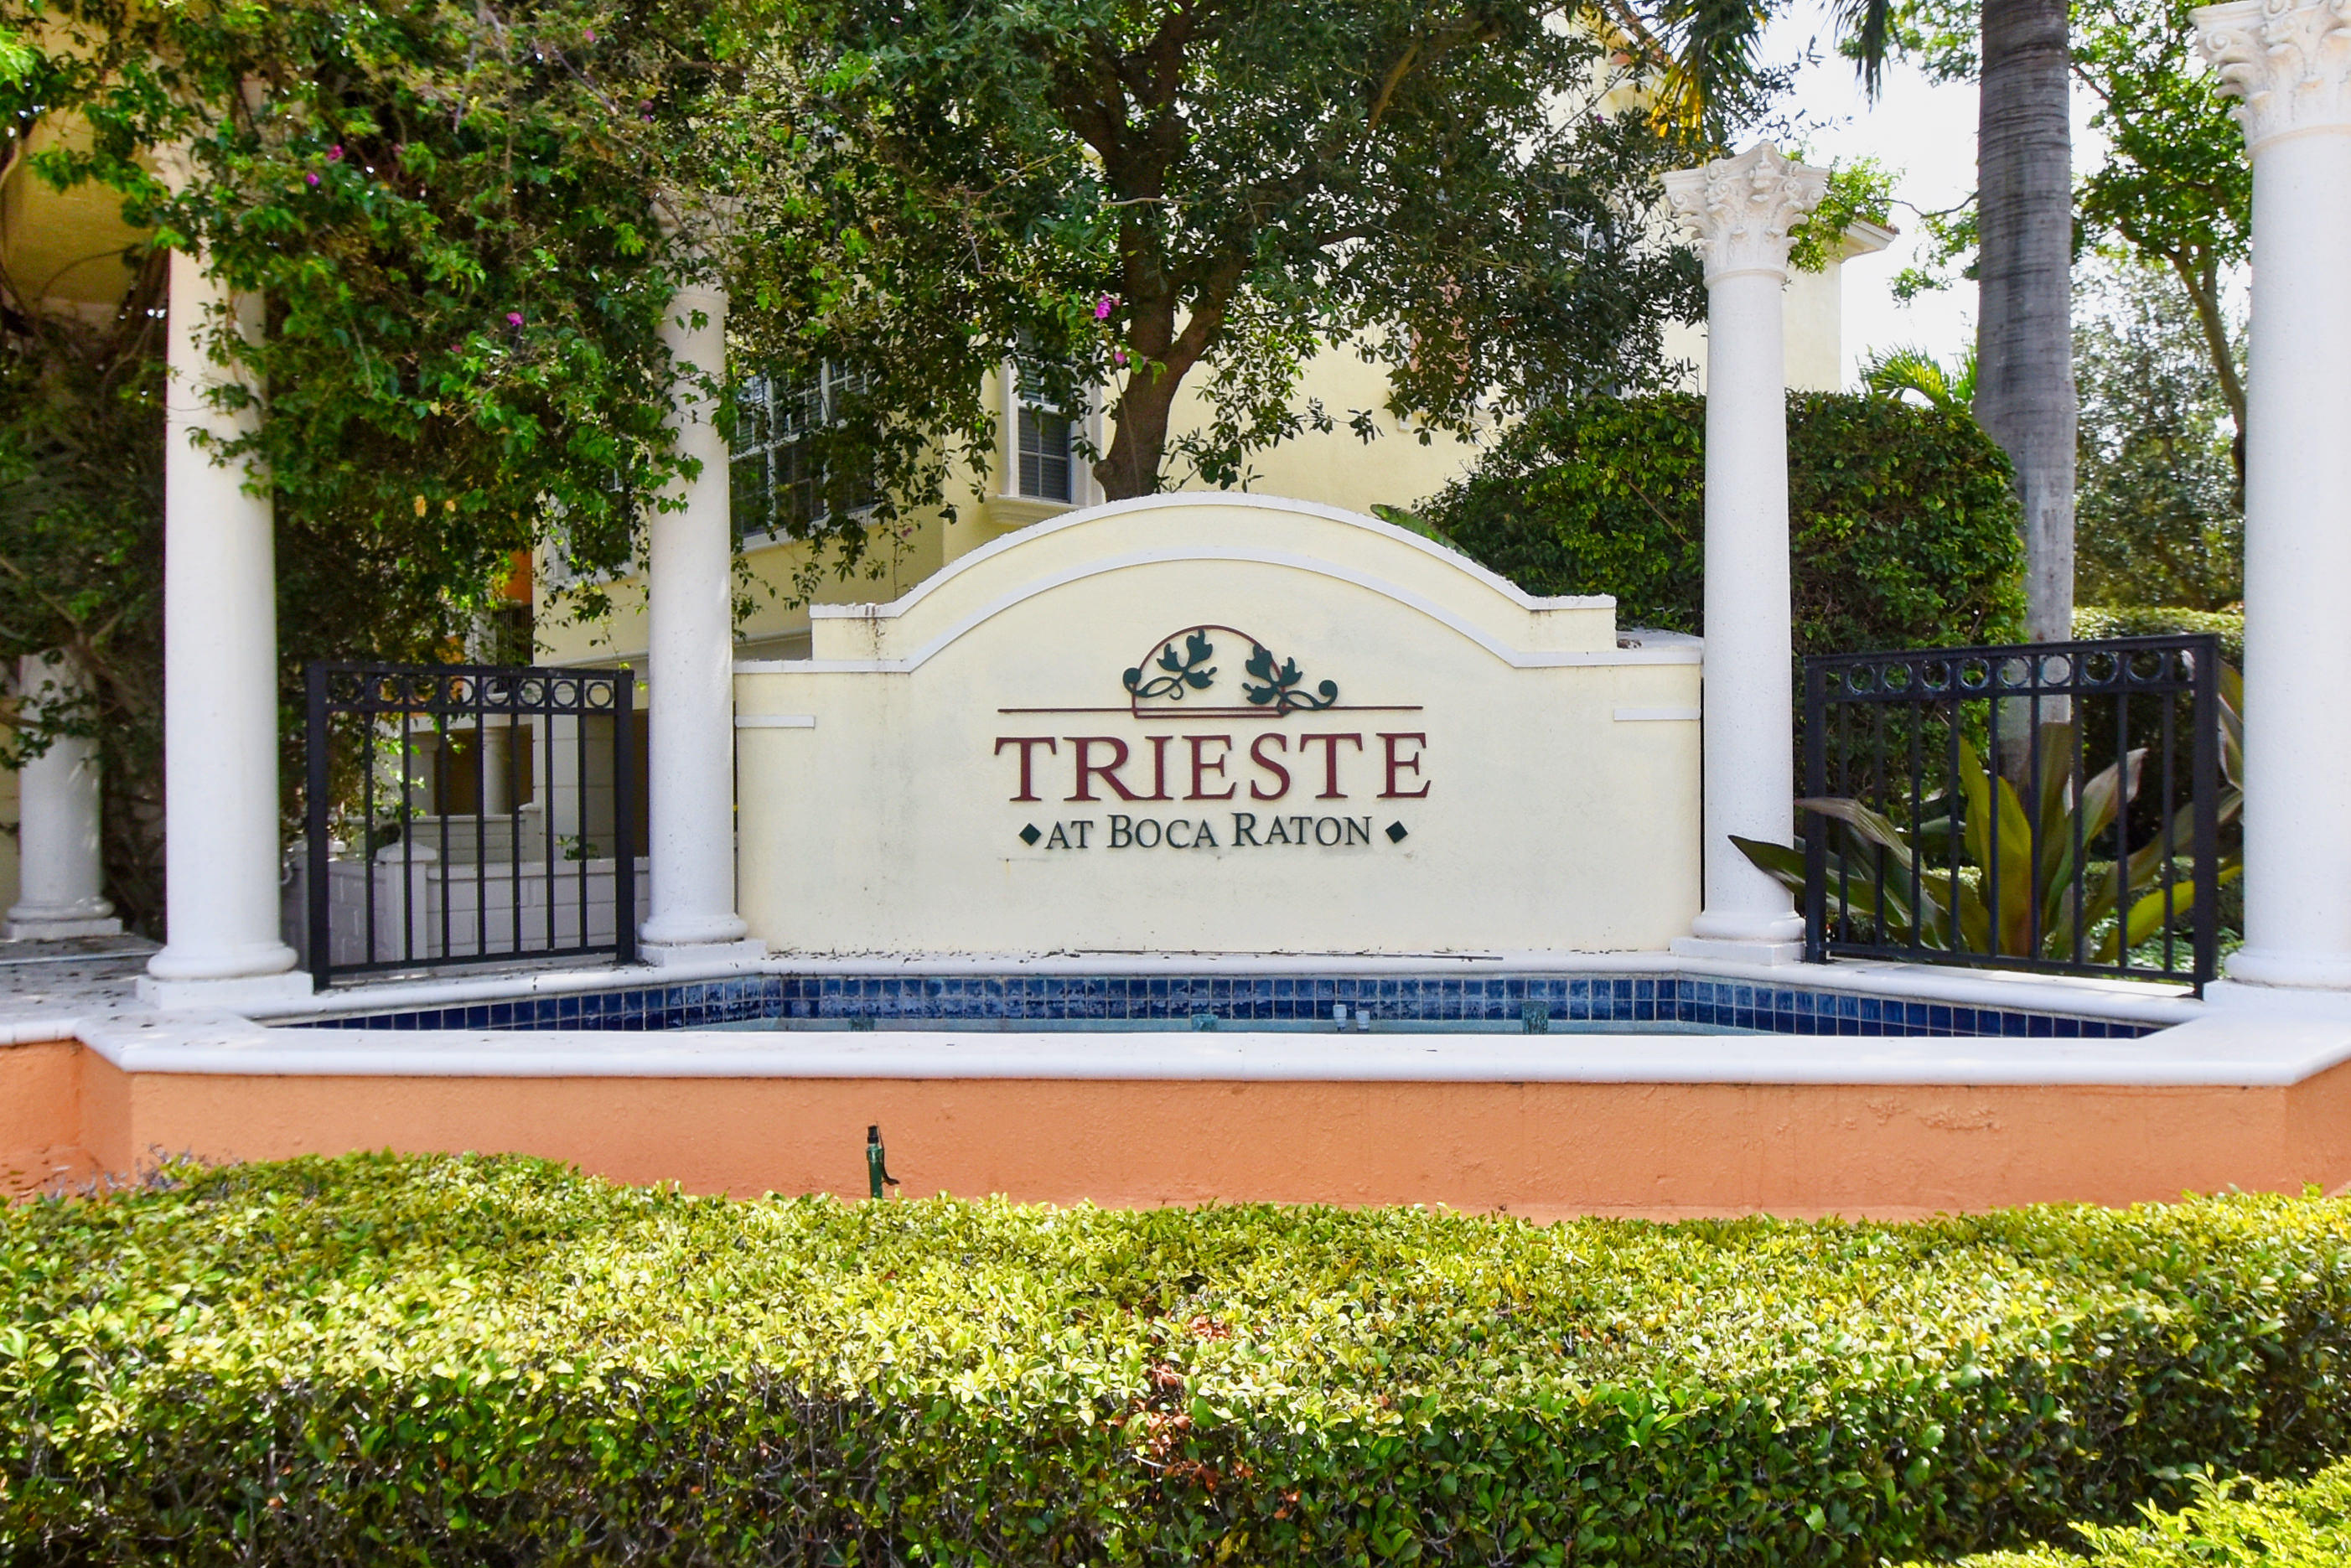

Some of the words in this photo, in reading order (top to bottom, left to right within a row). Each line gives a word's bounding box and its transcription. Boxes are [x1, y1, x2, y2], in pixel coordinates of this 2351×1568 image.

[994, 732, 1432, 802] TRIESTE
[1043, 820, 1095, 850] AT
[1106, 814, 1220, 850] BOCA
[1230, 812, 1373, 847] RATON
